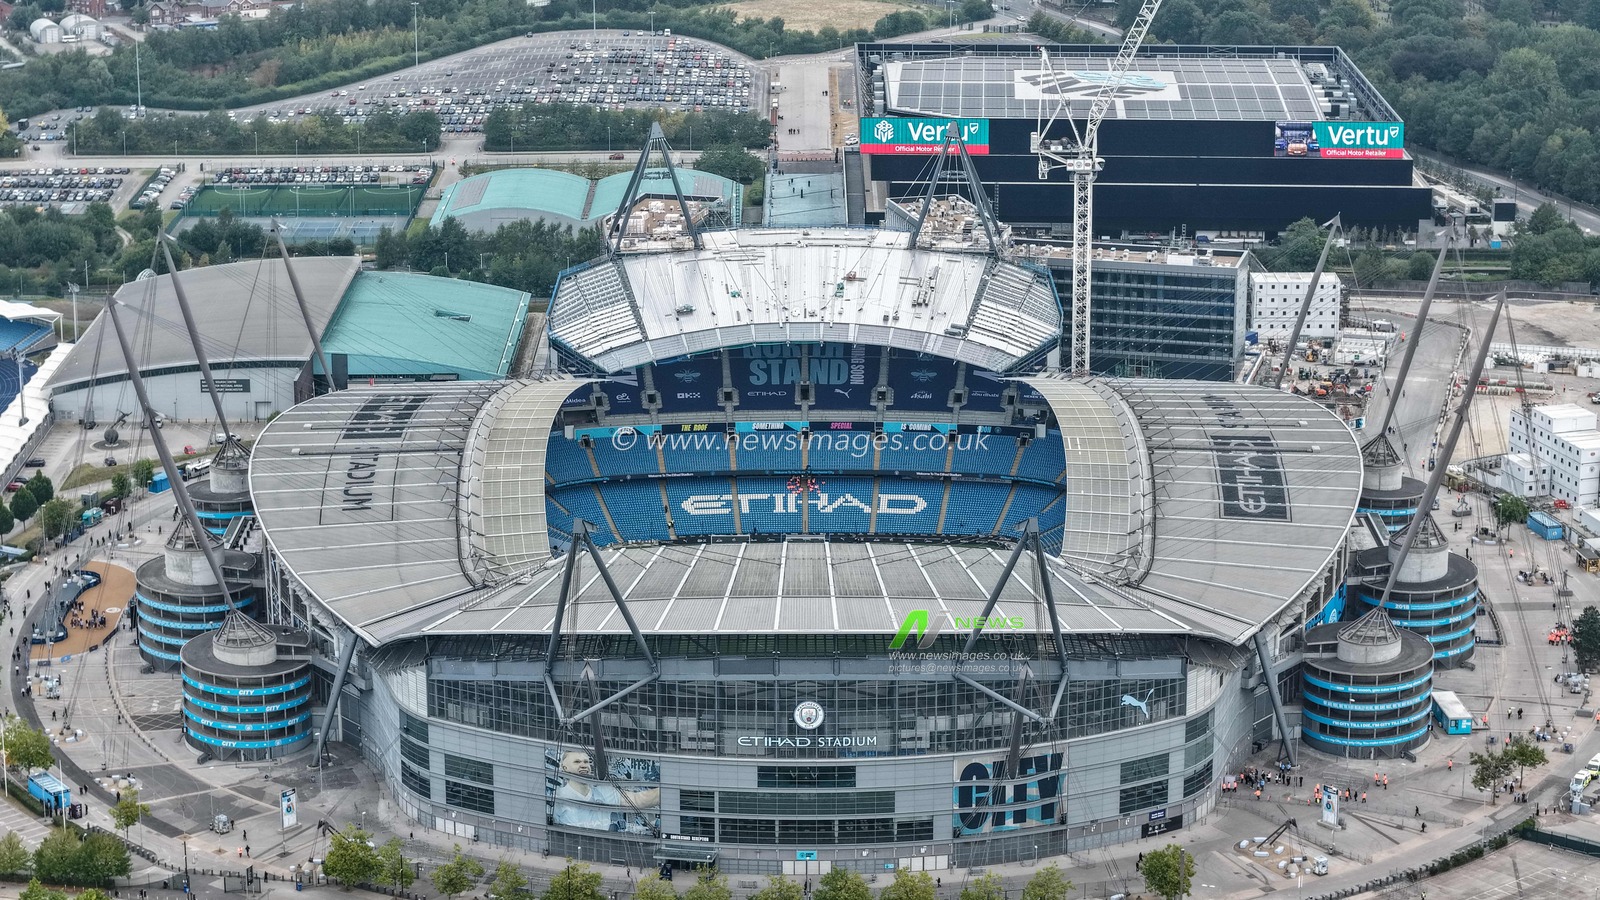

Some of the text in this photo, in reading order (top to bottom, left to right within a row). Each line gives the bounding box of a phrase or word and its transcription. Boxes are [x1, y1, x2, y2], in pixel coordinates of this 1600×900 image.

[908, 122, 968, 141] Veru
[1328, 126, 1388, 145] Vertu
[749, 358, 849, 386] STAND
[850, 364, 865, 385] SOON
[681, 424, 692, 432] THE
[909, 423, 932, 431] COMING
[342, 447, 380, 511] TADIUM
[681, 493, 928, 516] ETIHAD
[738, 736, 877, 747] ETIHAD STADIUM
